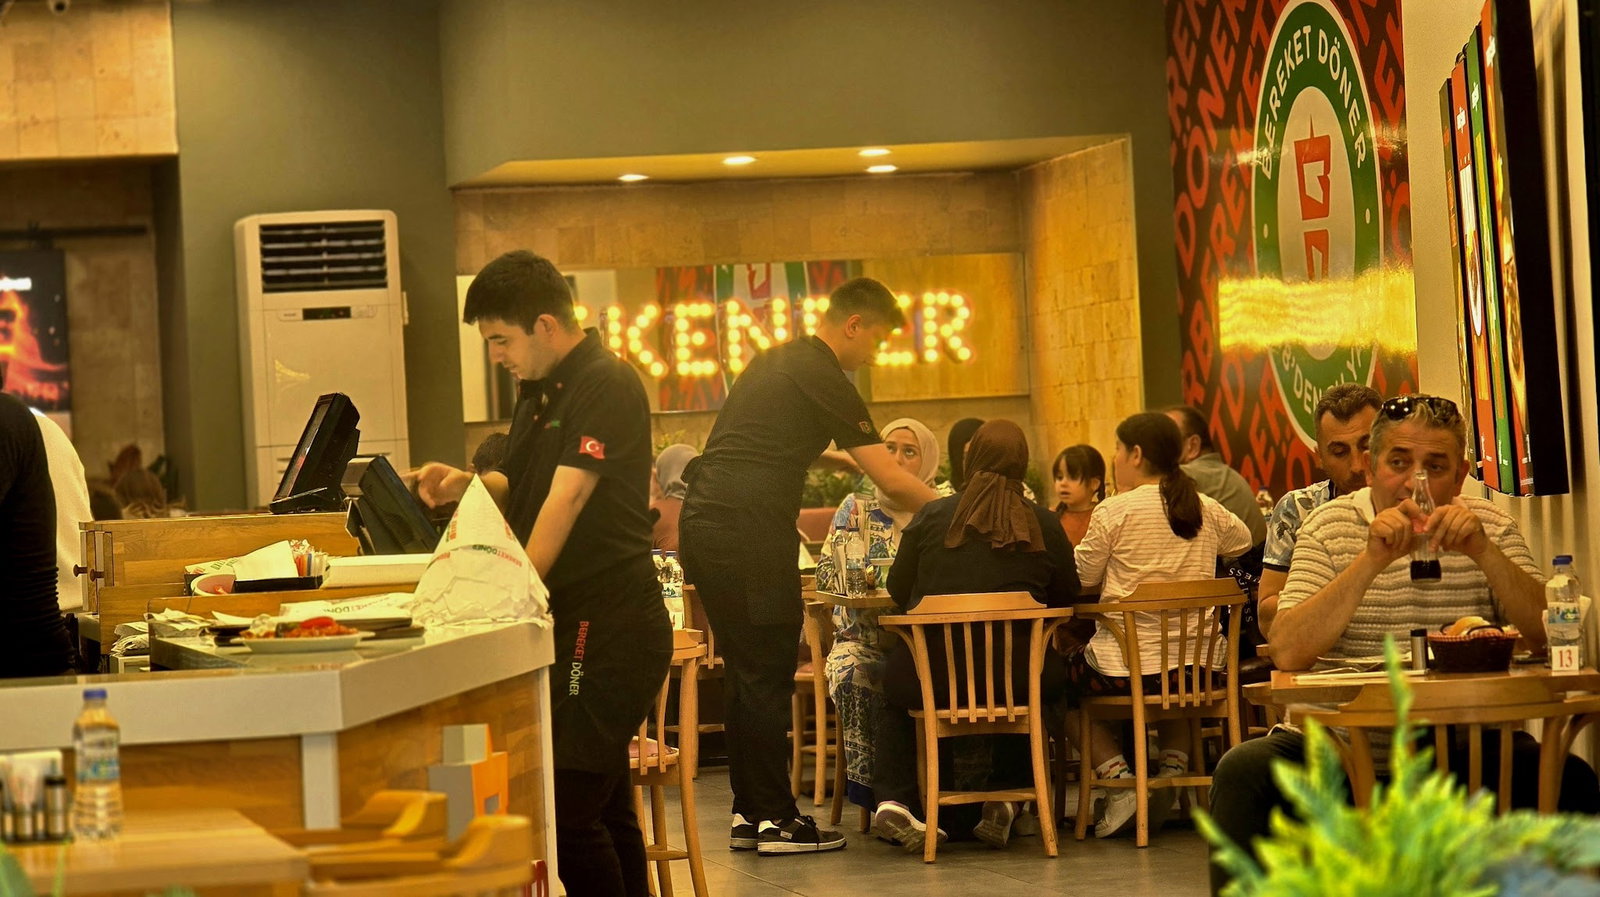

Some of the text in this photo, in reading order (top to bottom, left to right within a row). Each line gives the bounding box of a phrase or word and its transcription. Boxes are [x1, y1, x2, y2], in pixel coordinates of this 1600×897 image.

[1262, 25, 1313, 180] BEREKET
[1318, 28, 1367, 168] DÖNER
[569, 620, 590, 696] BEREKET DÖNER
[1558, 649, 1573, 668] 13
